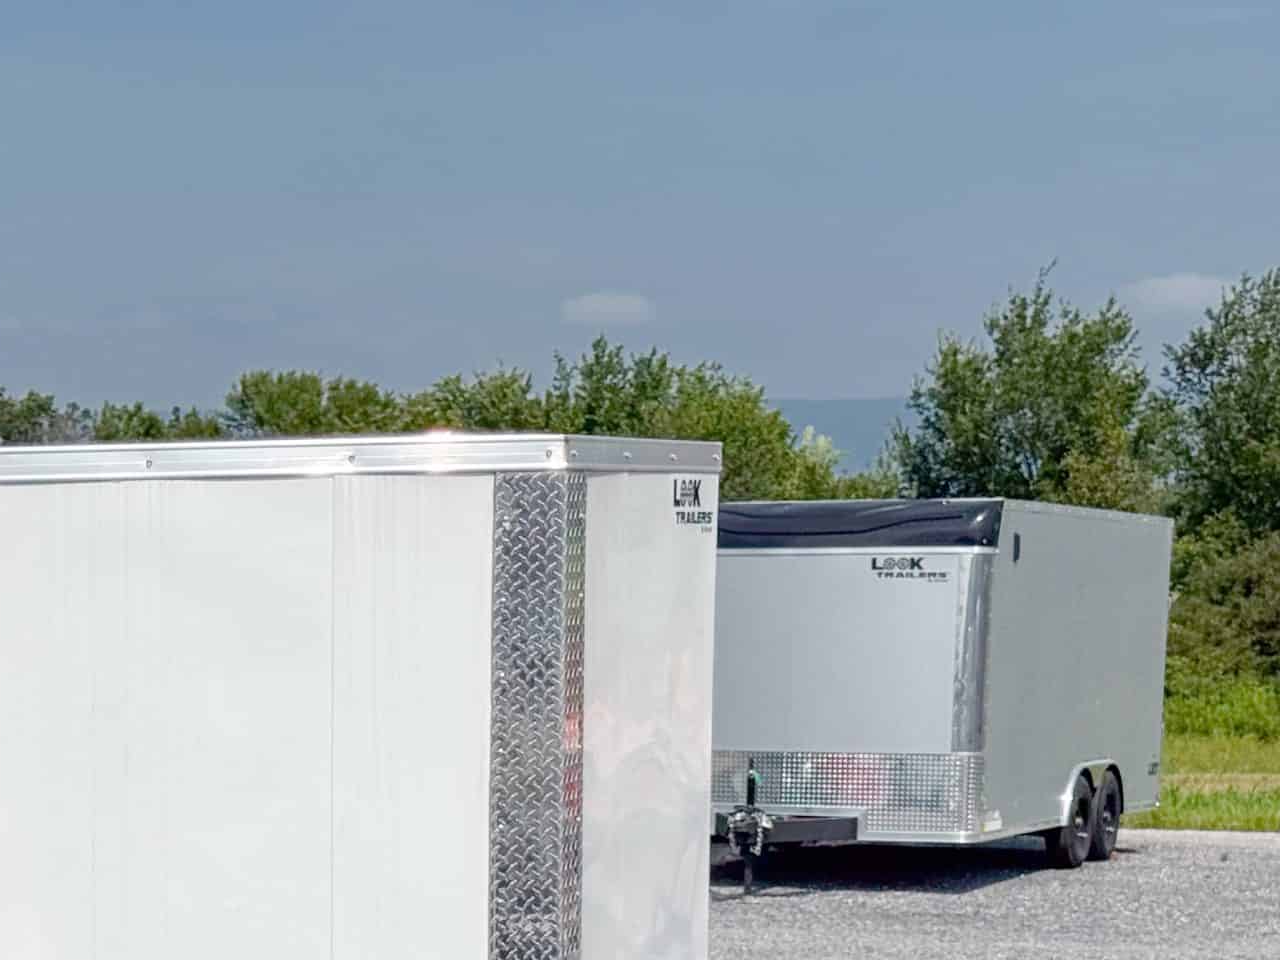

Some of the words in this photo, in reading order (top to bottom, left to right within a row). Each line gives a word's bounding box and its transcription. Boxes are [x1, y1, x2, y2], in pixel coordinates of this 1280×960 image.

[673, 479, 701, 507] LOOK
[676, 511, 713, 524] TRAILERS
[871, 557, 924, 570] LOOK
